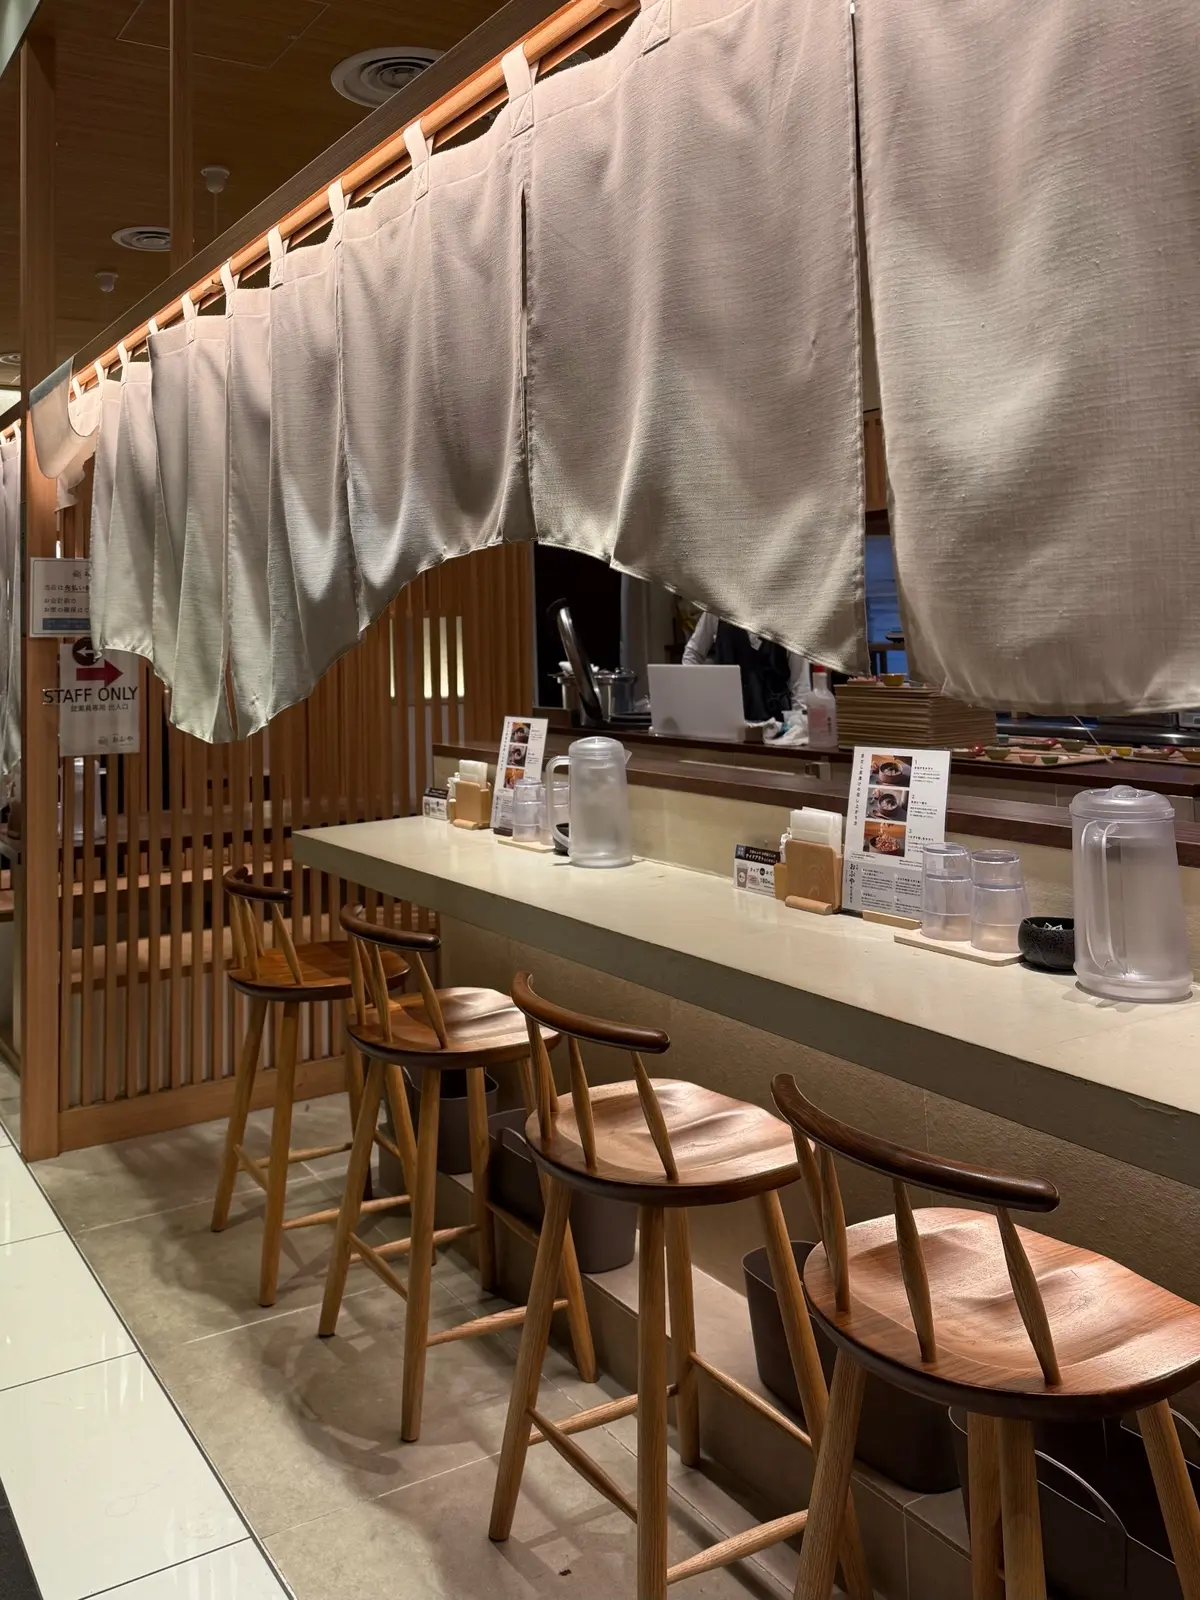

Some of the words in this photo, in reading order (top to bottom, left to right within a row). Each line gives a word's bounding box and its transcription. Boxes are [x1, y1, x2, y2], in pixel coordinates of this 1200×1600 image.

[44, 688, 92, 703] STAFF
[98, 686, 138, 701] ONLY
[108, 703, 129, 711] 出入口
